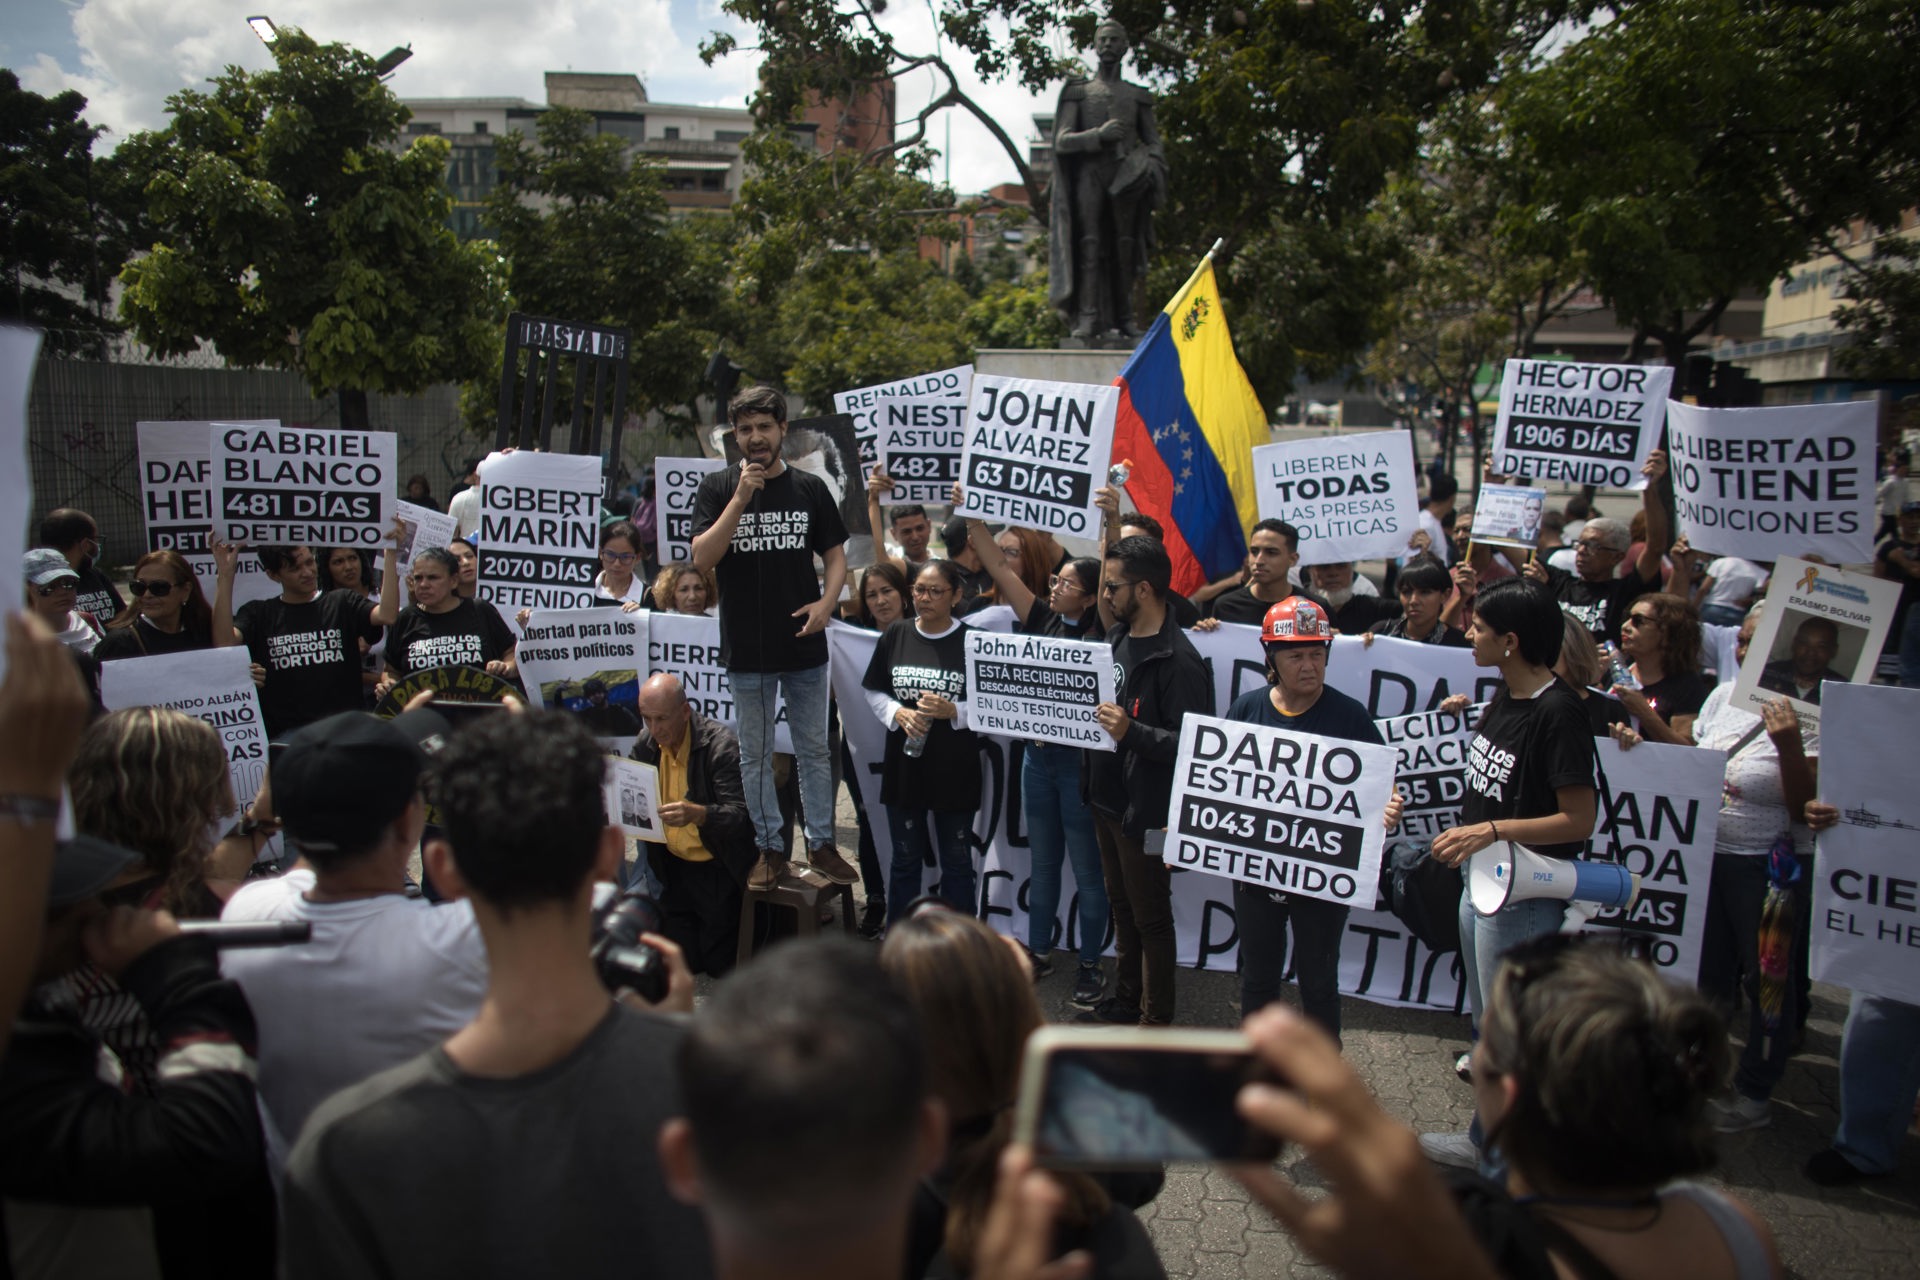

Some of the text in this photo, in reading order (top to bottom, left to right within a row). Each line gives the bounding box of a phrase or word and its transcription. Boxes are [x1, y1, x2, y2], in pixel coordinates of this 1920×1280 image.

[1517, 362, 1647, 394] HECTOR
[976, 386, 1095, 437] JOHN
[1512, 393, 1644, 422] HERNADEZ
[223, 429, 380, 458] GABRIEL
[972, 426, 1091, 466] ALVAREZ
[1513, 424, 1632, 454] 1906 DÍAS
[1670, 428, 1856, 464] LA LIBERTAD
[224, 458, 382, 487] BLANCO
[890, 456, 940, 478] 482
[1272, 452, 1389, 478] LIBEREN A
[1502, 454, 1631, 488] DETENIDO
[974, 460, 1074, 500] 63 DÍAS
[1276, 472, 1391, 503] TODAS
[1672, 458, 1858, 502] NO TIENE
[147, 490, 212, 521] HE
[226, 492, 371, 519] 481 DÍAS
[481, 484, 601, 517] IGBERT
[966, 490, 1086, 533] DETENIDO
[1280, 498, 1396, 524] LAS PRESAS
[1674, 494, 1860, 534] CONDICIONES
[480, 512, 596, 550] MARÍN
[785, 511, 809, 524] LOS
[793, 522, 809, 534] DE
[1297, 516, 1398, 541] OLÍTICAS
[228, 524, 382, 545] DETENIDO
[730, 535, 806, 554] TORTURA
[484, 556, 592, 583] 2070 DÍAS
[478, 584, 594, 610] DETENIDO
[1788, 596, 1872, 624] ERASMO BOLIVAR
[267, 628, 342, 648] CIERREN LOS
[408, 634, 481, 650] CIERREN LOS
[579, 622, 610, 639] para
[614, 620, 636, 636] los
[270, 638, 343, 658] CENTROS DE
[270, 650, 344, 671] TORTURA
[408, 642, 482, 658] CENTROS DE
[408, 651, 483, 670] TORTURA
[520, 642, 635, 664] presos políticos
[974, 637, 1093, 666] John Álvarez
[456, 668, 495, 693] LOS
[892, 666, 965, 684] CIERREN LOS
[892, 676, 962, 694] CENTROS DE
[978, 664, 1096, 690] ESTÁ RECIBIENDO
[206, 690, 252, 707] ALBÁN
[980, 680, 1096, 704] DESCARGAS ELÉCTRICAS
[977, 696, 1100, 724] EN LOS TESTÍCULOS
[224, 728, 259, 744] CON
[977, 714, 1102, 743] Y EN LAS COSTILLAS
[1192, 724, 1363, 786] DARIO
[1488, 745, 1516, 769] LOS
[1488, 762, 1512, 784] DE
[1186, 762, 1362, 820] ESTRADA
[1189, 803, 1343, 857] 1043 DÍAS
[1178, 840, 1357, 900] DETENIDO
[1533, 872, 1554, 882] PYLE
[1830, 868, 1918, 913] CIE
[1826, 908, 1864, 936] EL
